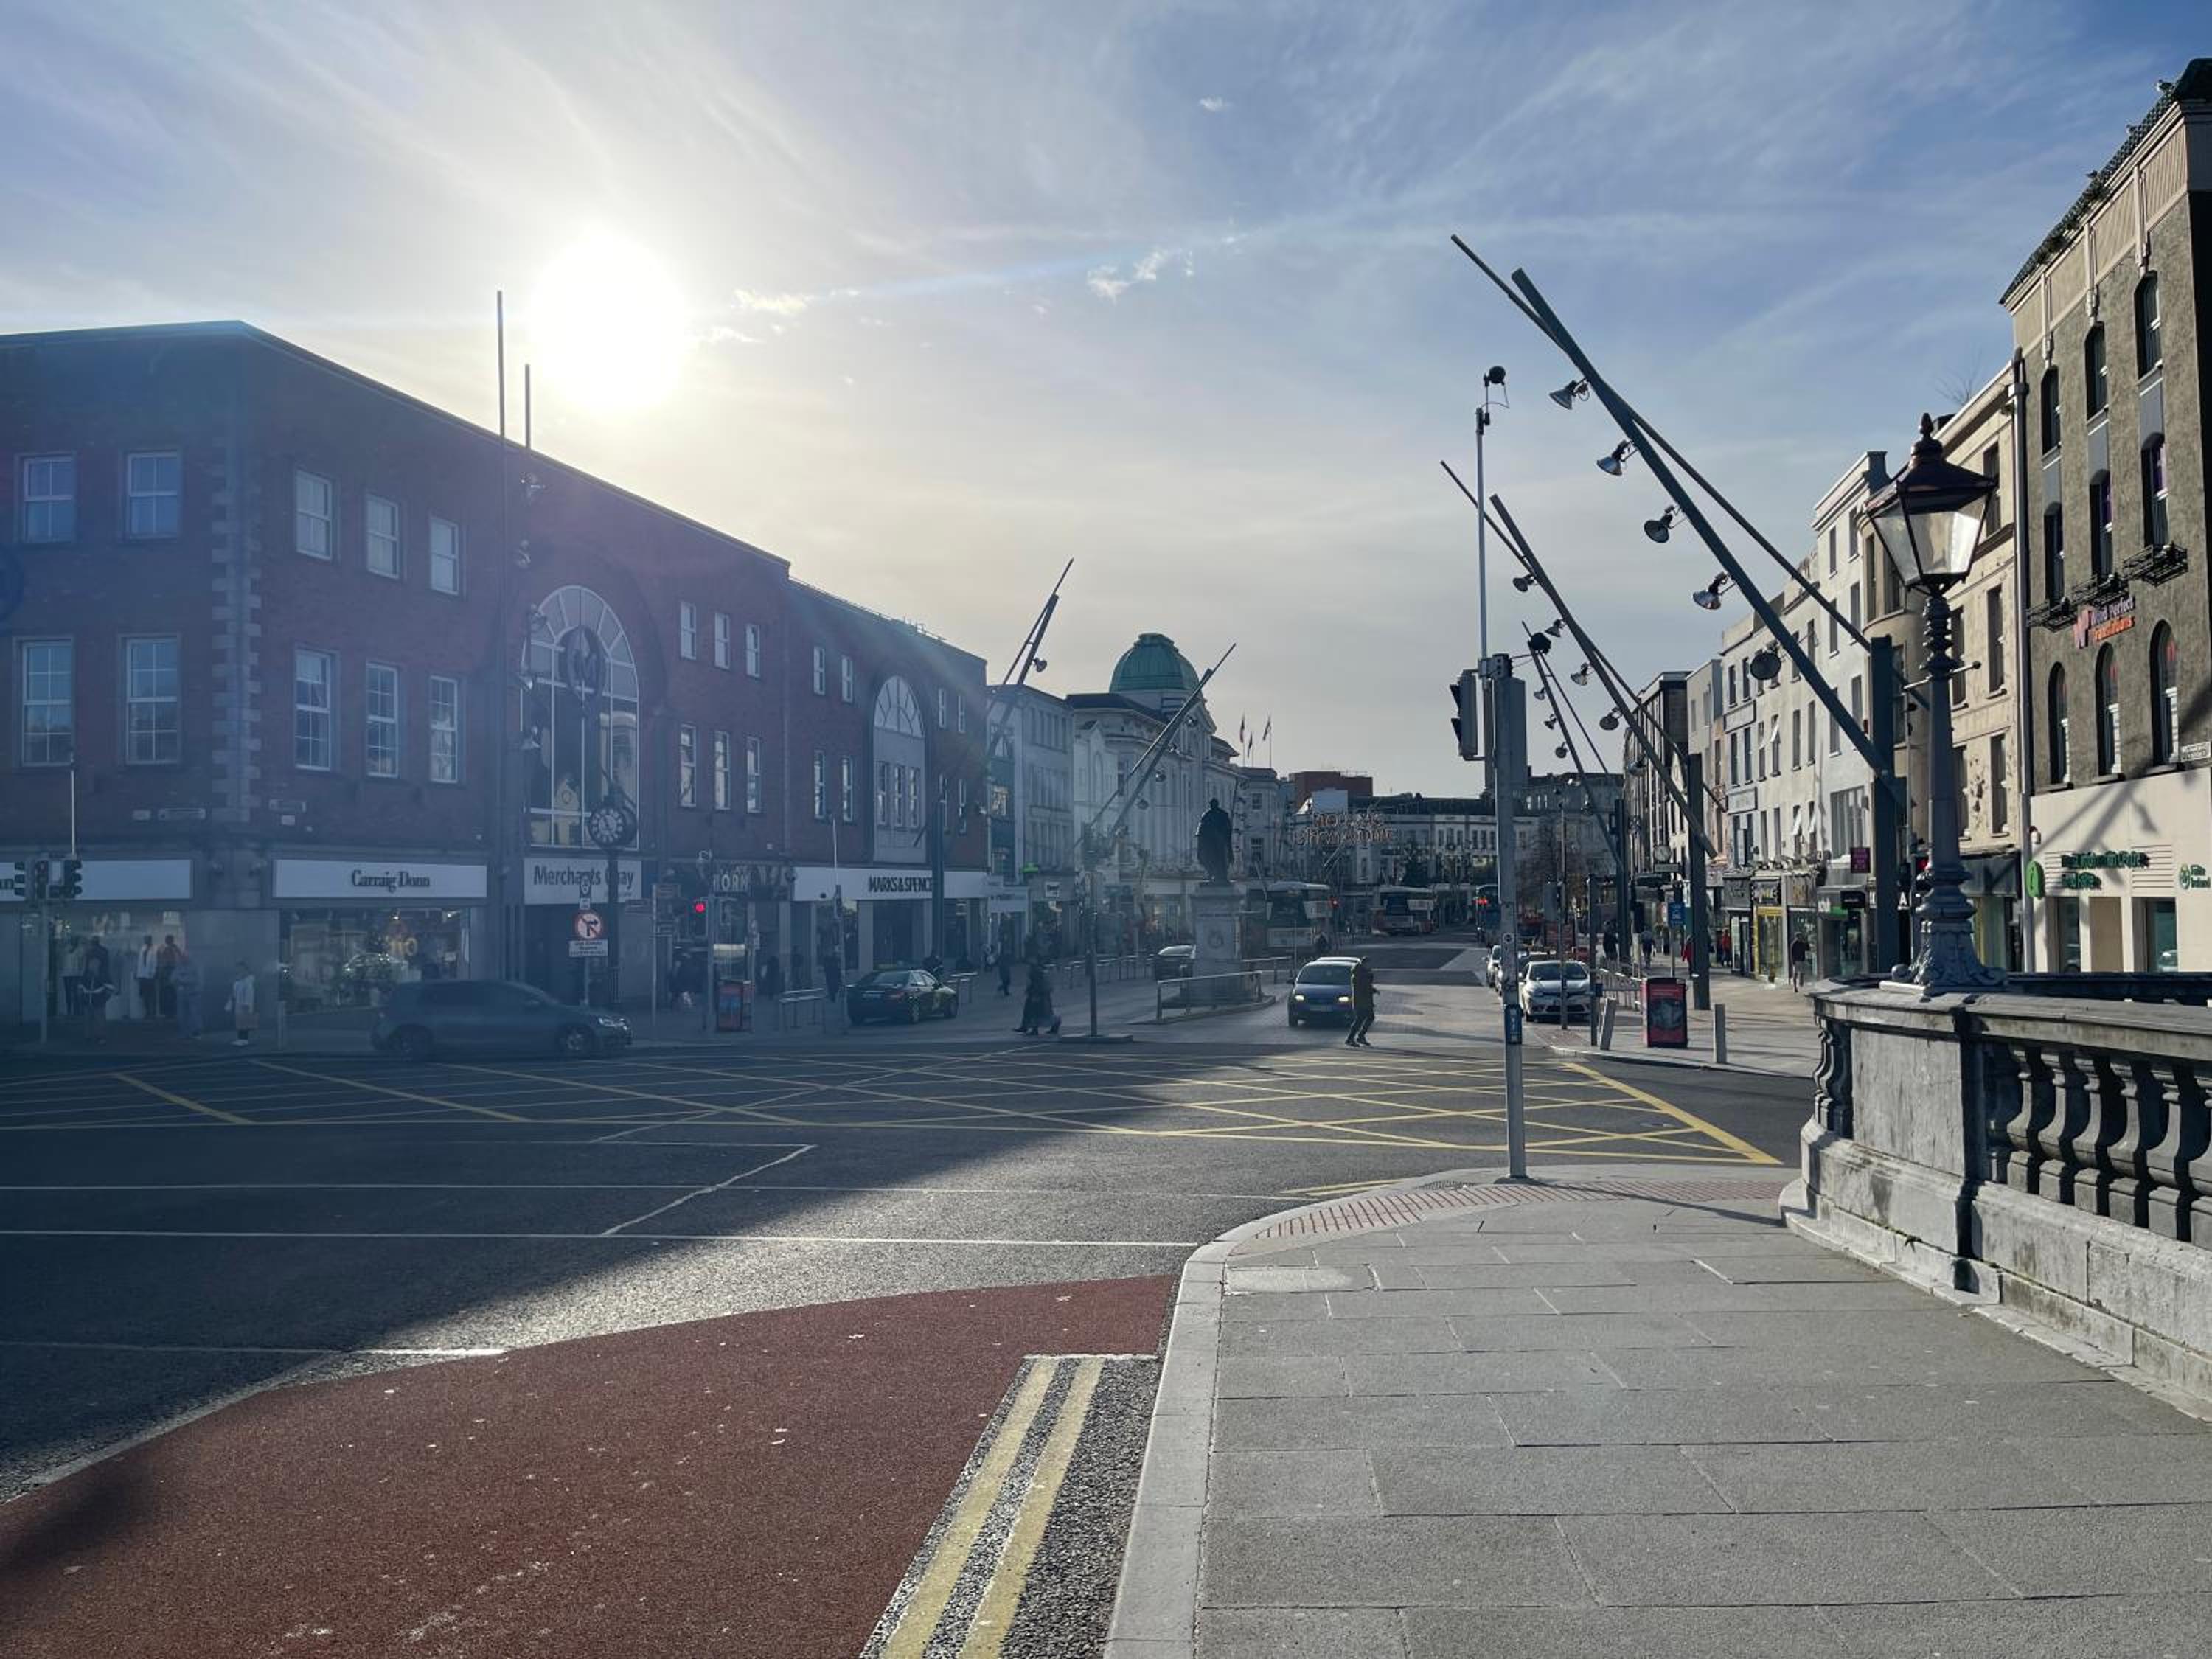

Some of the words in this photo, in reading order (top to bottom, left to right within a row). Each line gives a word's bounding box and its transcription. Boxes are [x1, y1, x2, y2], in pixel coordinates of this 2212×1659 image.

[2108, 596, 2134, 618] Perfect
[352, 869, 396, 893] Carraig
[399, 871, 430, 887] Donn
[535, 866, 601, 886] Merchats
